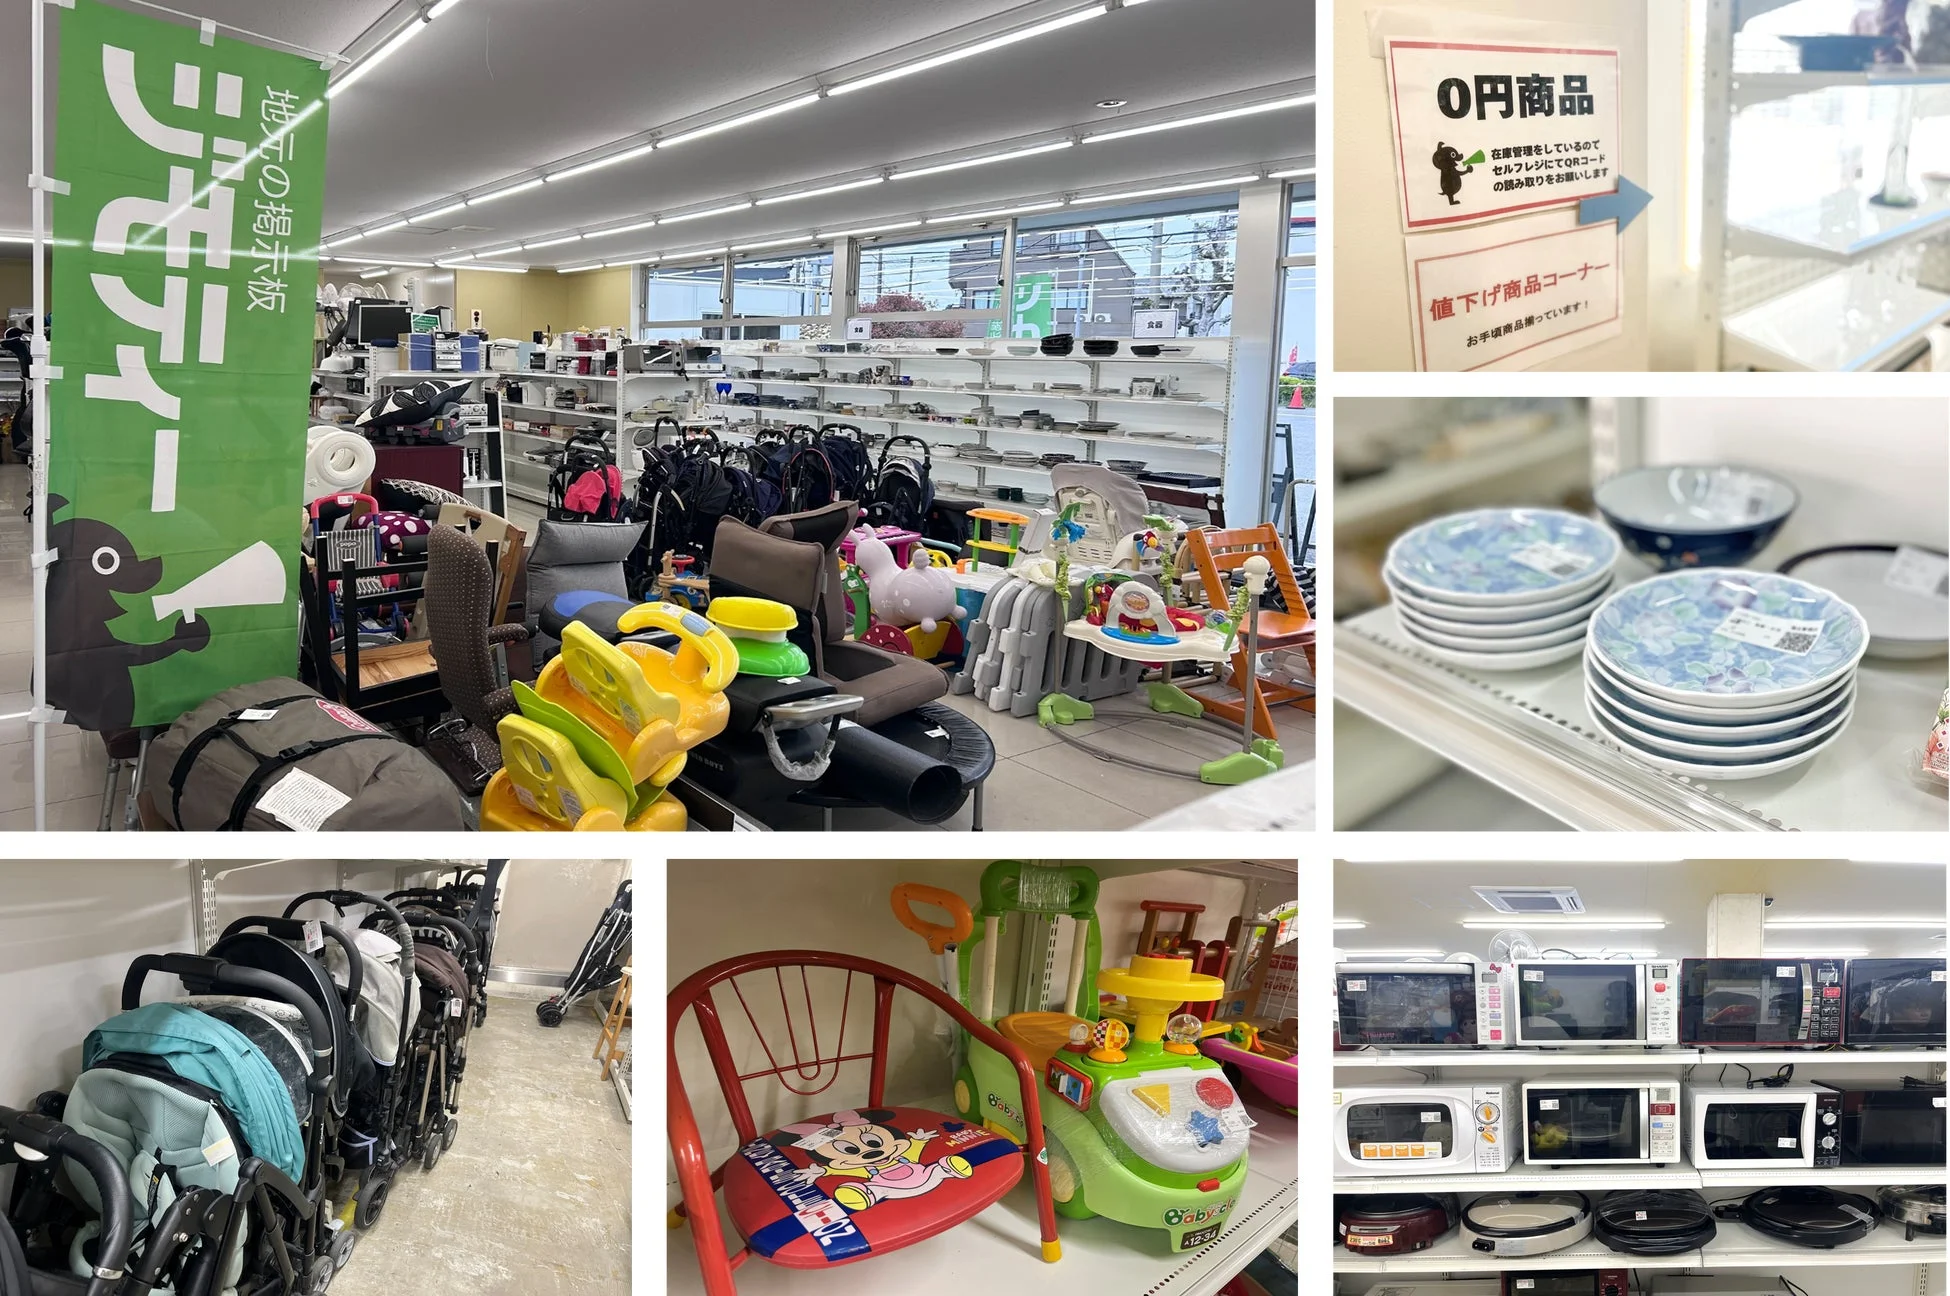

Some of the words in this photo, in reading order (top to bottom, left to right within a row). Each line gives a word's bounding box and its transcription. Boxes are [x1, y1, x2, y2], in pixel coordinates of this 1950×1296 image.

[1437, 73, 1594, 121] 0円商品
[1491, 139, 1601, 161] 在庫管理をしているので
[1492, 153, 1606, 177] セルフレジにてQRコード
[246, 84, 300, 314] 地元の掲示板
[1493, 167, 1609, 193] の読み取りをお願いします
[85, 43, 247, 513] ジモティー
[1429, 262, 1610, 322] 値下げ商品コーナー
